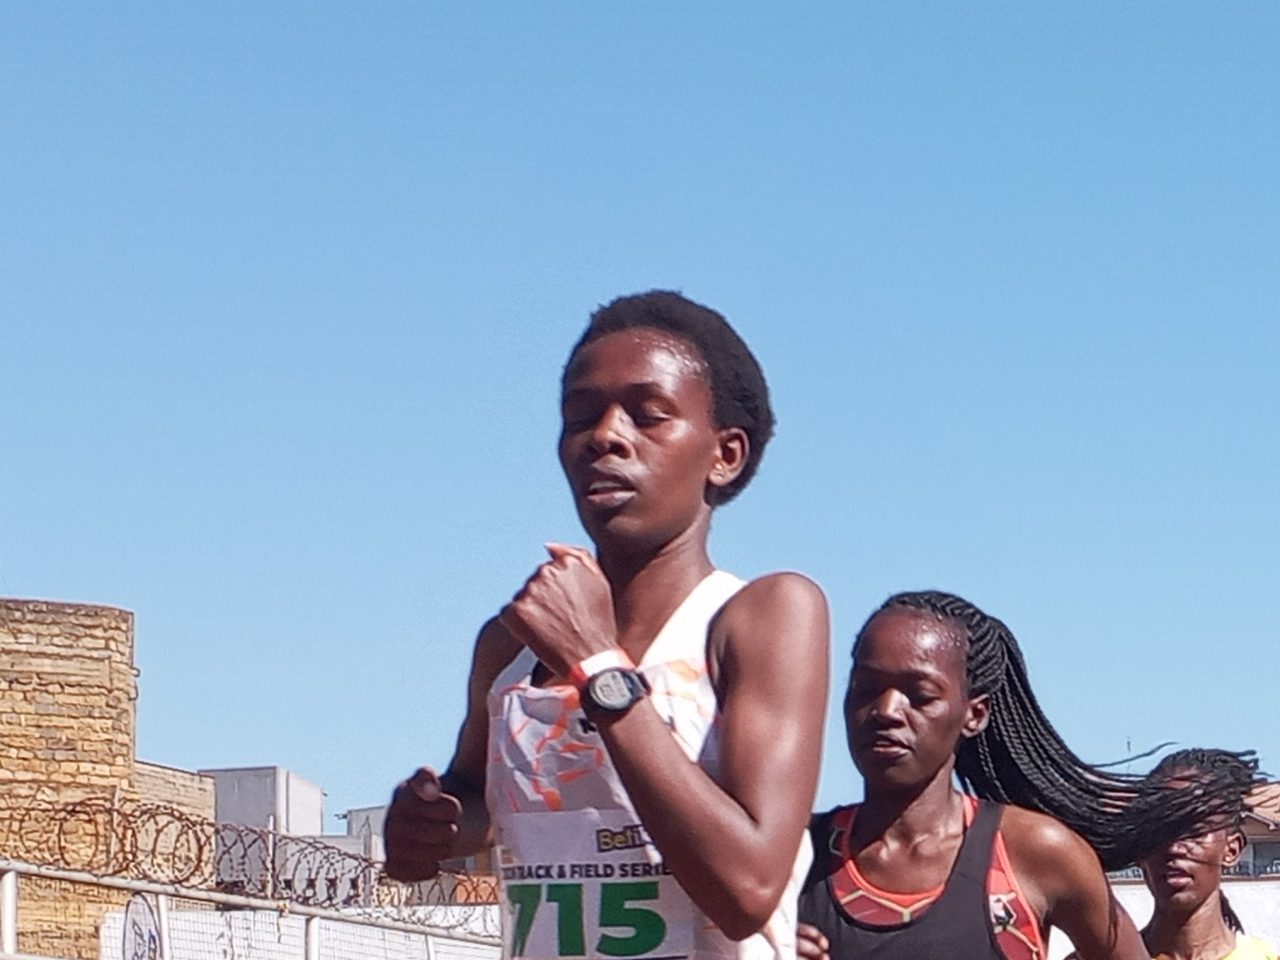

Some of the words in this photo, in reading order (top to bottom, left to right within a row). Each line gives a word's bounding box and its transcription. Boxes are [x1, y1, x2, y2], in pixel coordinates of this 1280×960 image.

[598, 826, 648, 851] Beti
[570, 864, 614, 877] FIELD
[619, 862, 672, 877] SERIE
[507, 882, 667, 957] 715
